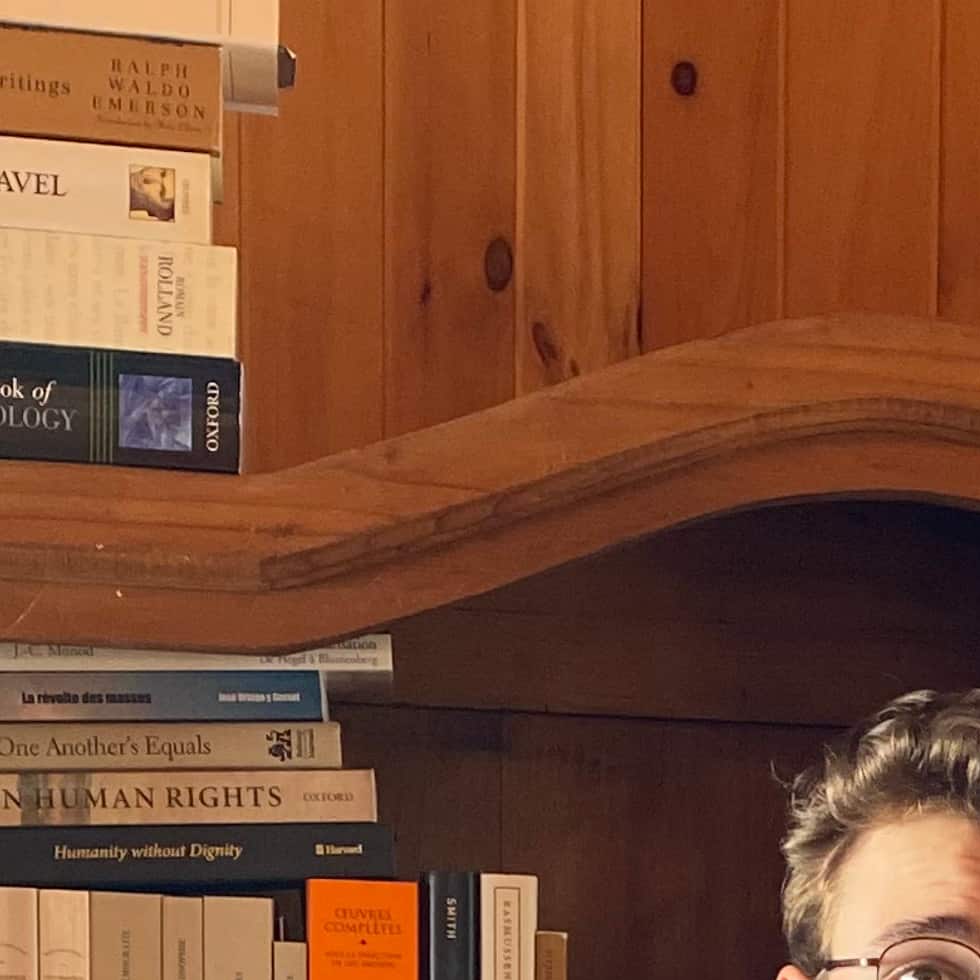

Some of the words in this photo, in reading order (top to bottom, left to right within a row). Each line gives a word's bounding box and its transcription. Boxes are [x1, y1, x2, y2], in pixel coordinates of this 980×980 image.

[110, 57, 189, 79] RALPH
[107, 76, 191, 99] WALDO
[91, 96, 207, 120] EMERSON
[156, 256, 175, 337] ROLLAND
[32, 379, 57, 407] of
[205, 381, 221, 452] OXFORD
[22, 691, 35, 704] La
[82, 691, 104, 704] des
[0, 738, 40, 757] One
[46, 736, 139, 757] Another's
[145, 734, 212, 762] Equals
[33, 785, 155, 810] HUMAN
[165, 785, 284, 808] RIGHTS
[303, 792, 355, 802] OXFORD
[54, 845, 128, 862] Humanity
[131, 844, 187, 860] without
[189, 842, 243, 862] Dignity
[446, 897, 457, 940] SMITH
